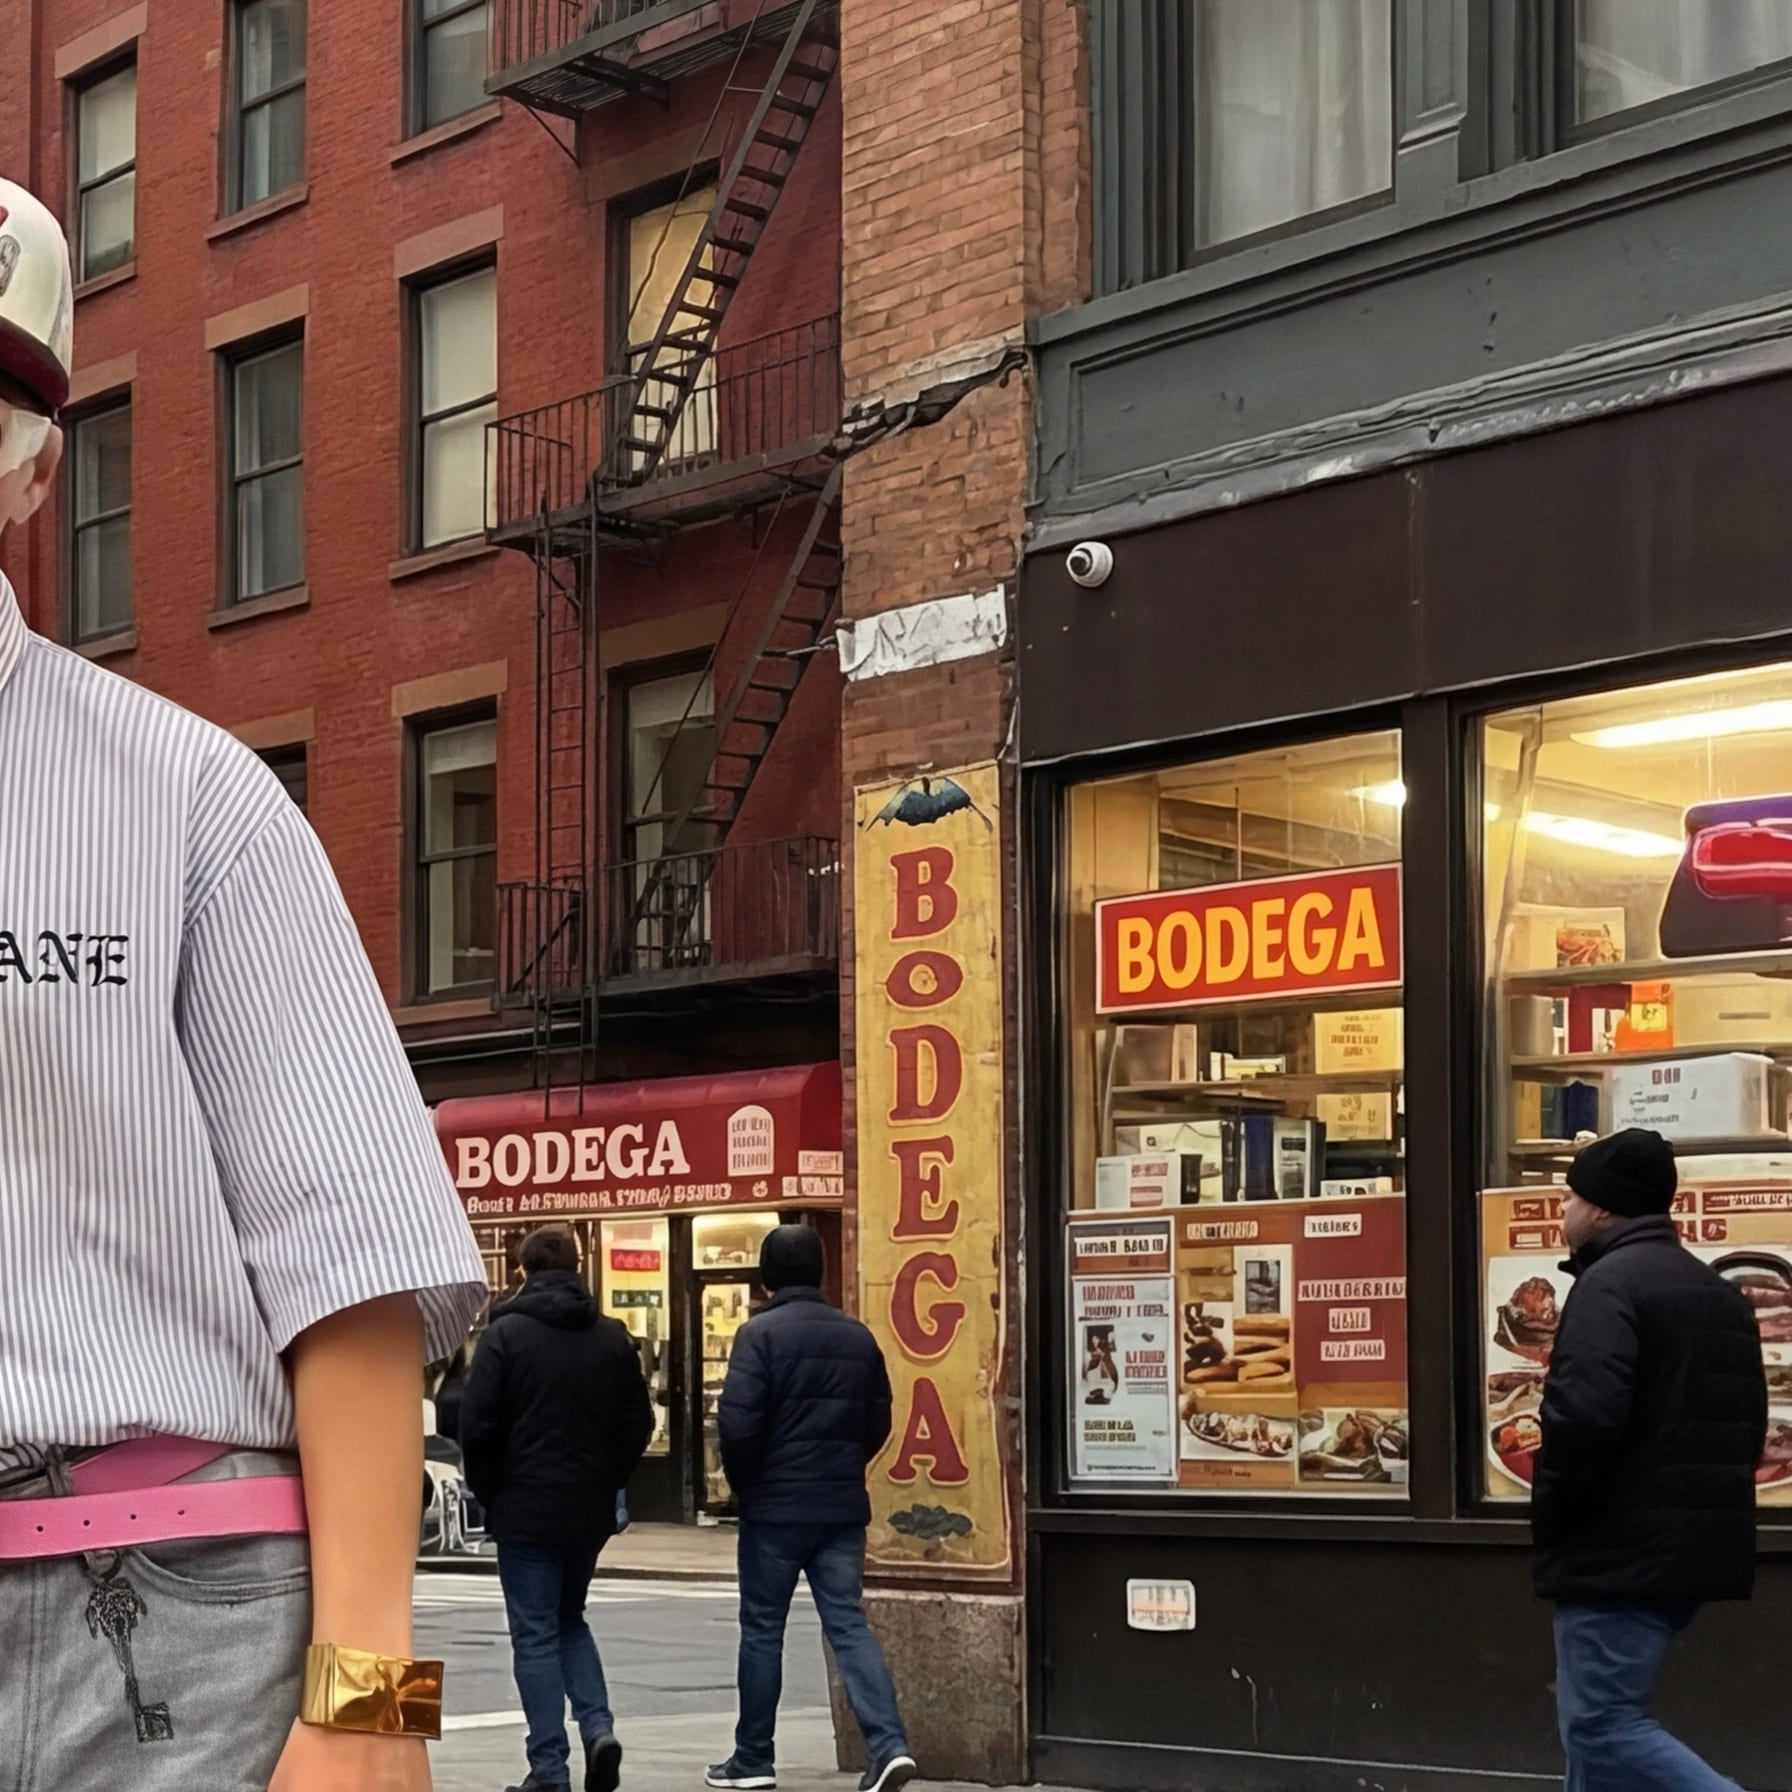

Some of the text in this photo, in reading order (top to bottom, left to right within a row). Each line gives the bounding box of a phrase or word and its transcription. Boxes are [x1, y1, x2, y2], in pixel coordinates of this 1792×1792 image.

[1117, 886, 1386, 994] BODEGA
[455, 1119, 690, 1189] BODEGA
[886, 843, 969, 1486] BODEGA
